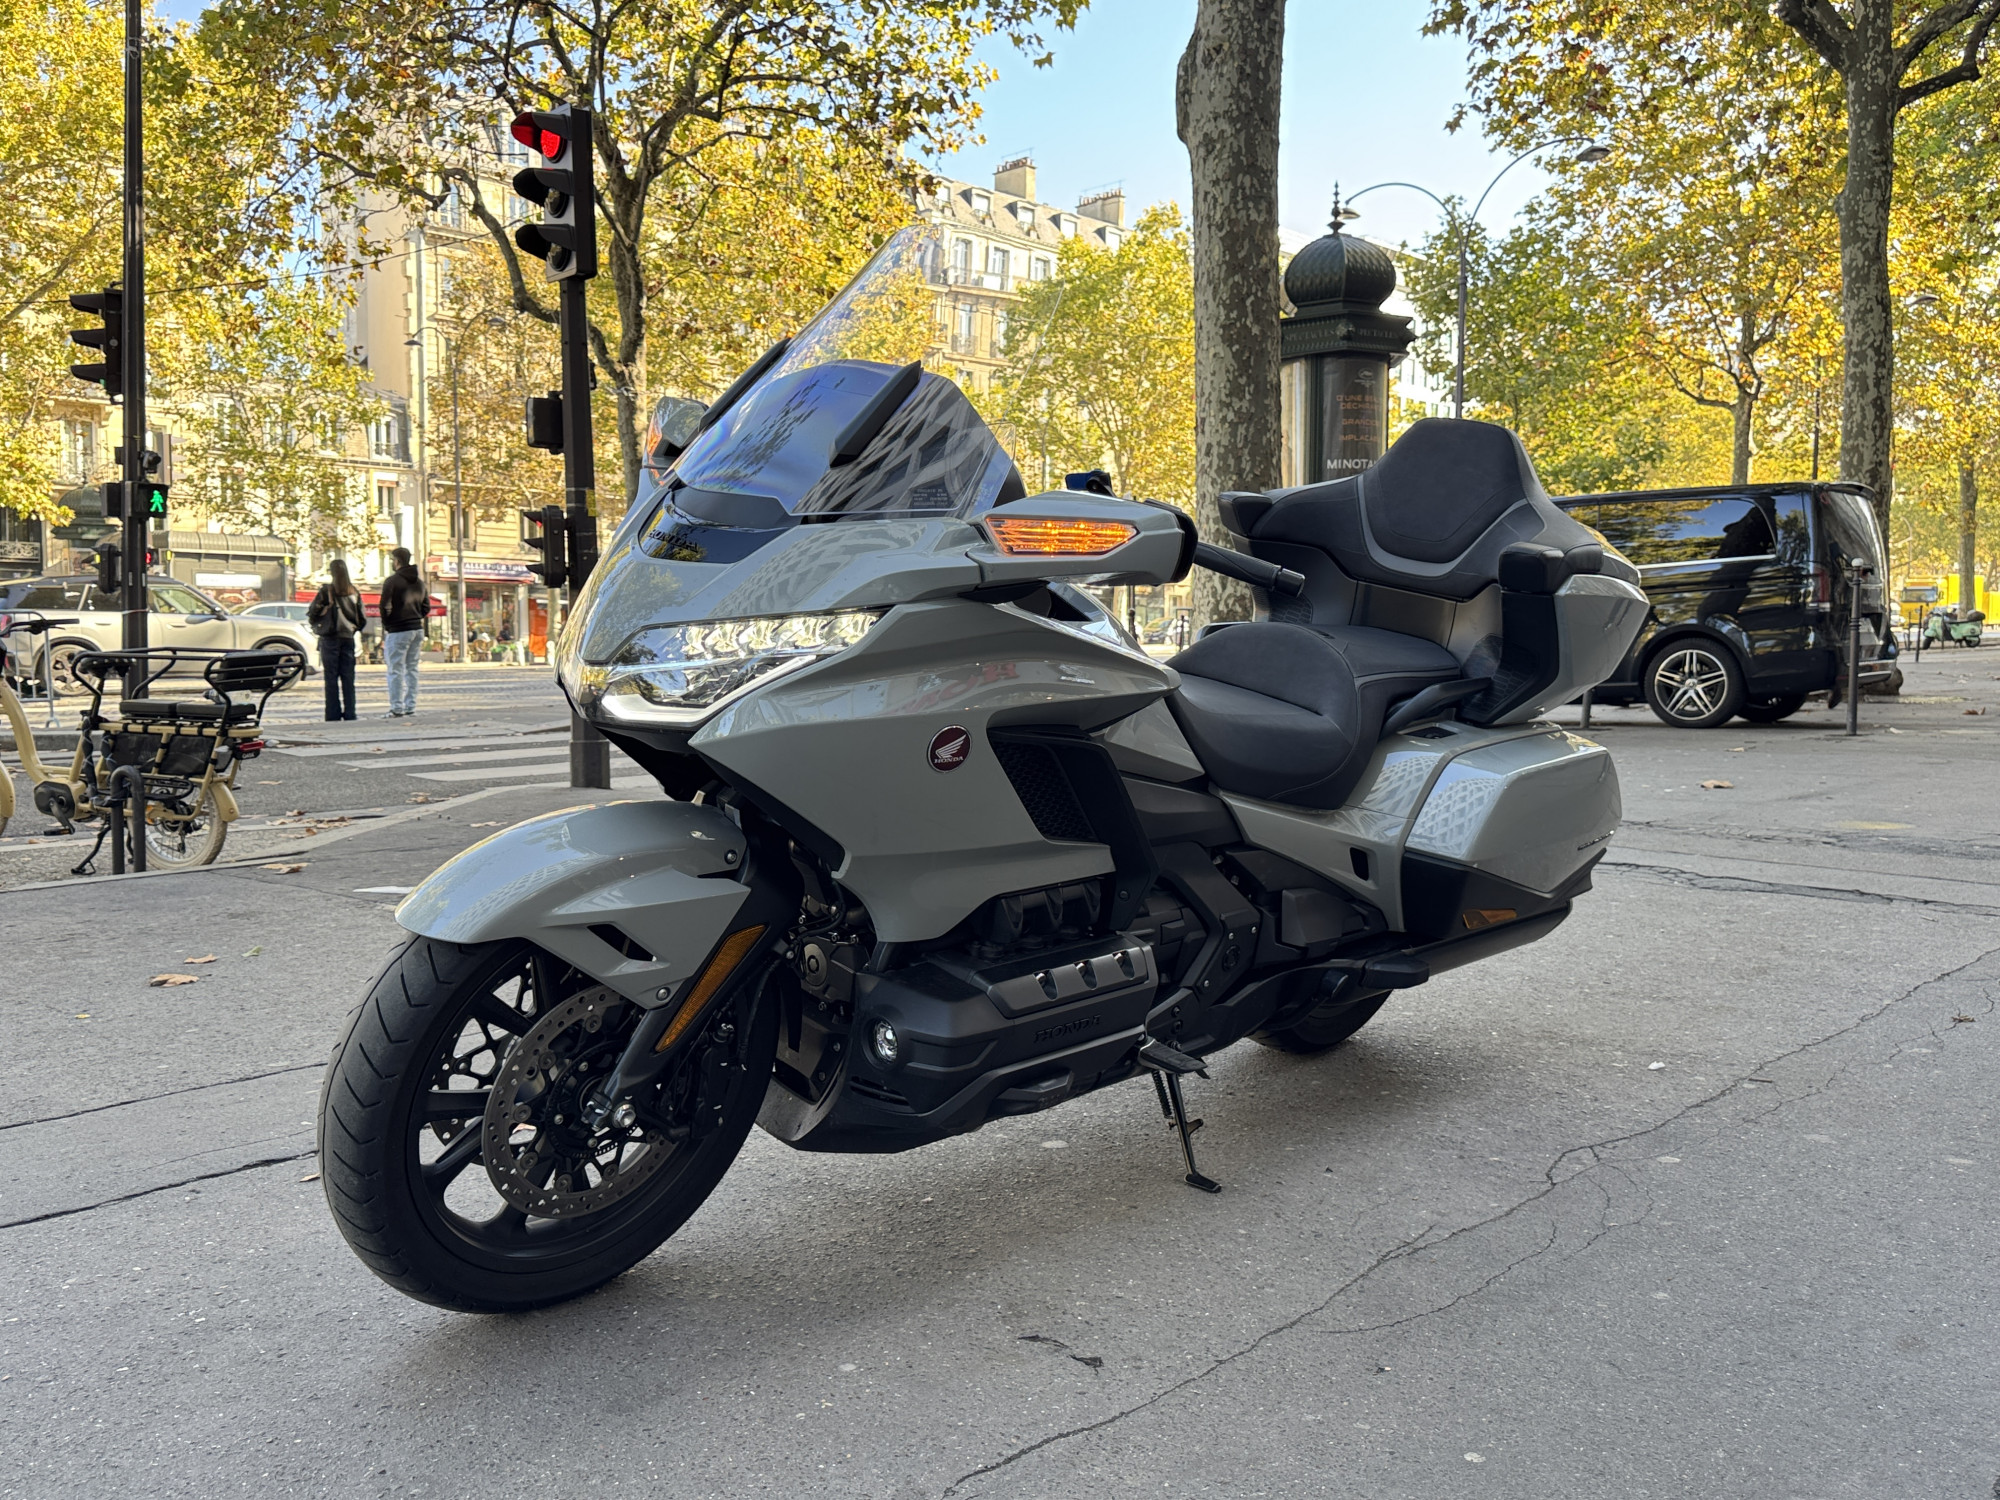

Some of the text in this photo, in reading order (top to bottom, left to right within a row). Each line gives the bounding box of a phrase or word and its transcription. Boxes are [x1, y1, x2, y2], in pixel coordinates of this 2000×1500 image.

[1326, 458, 1377, 470] MINOTA
[934, 756, 964, 764] HONDA
[1033, 1014, 1101, 1043] HONDA
